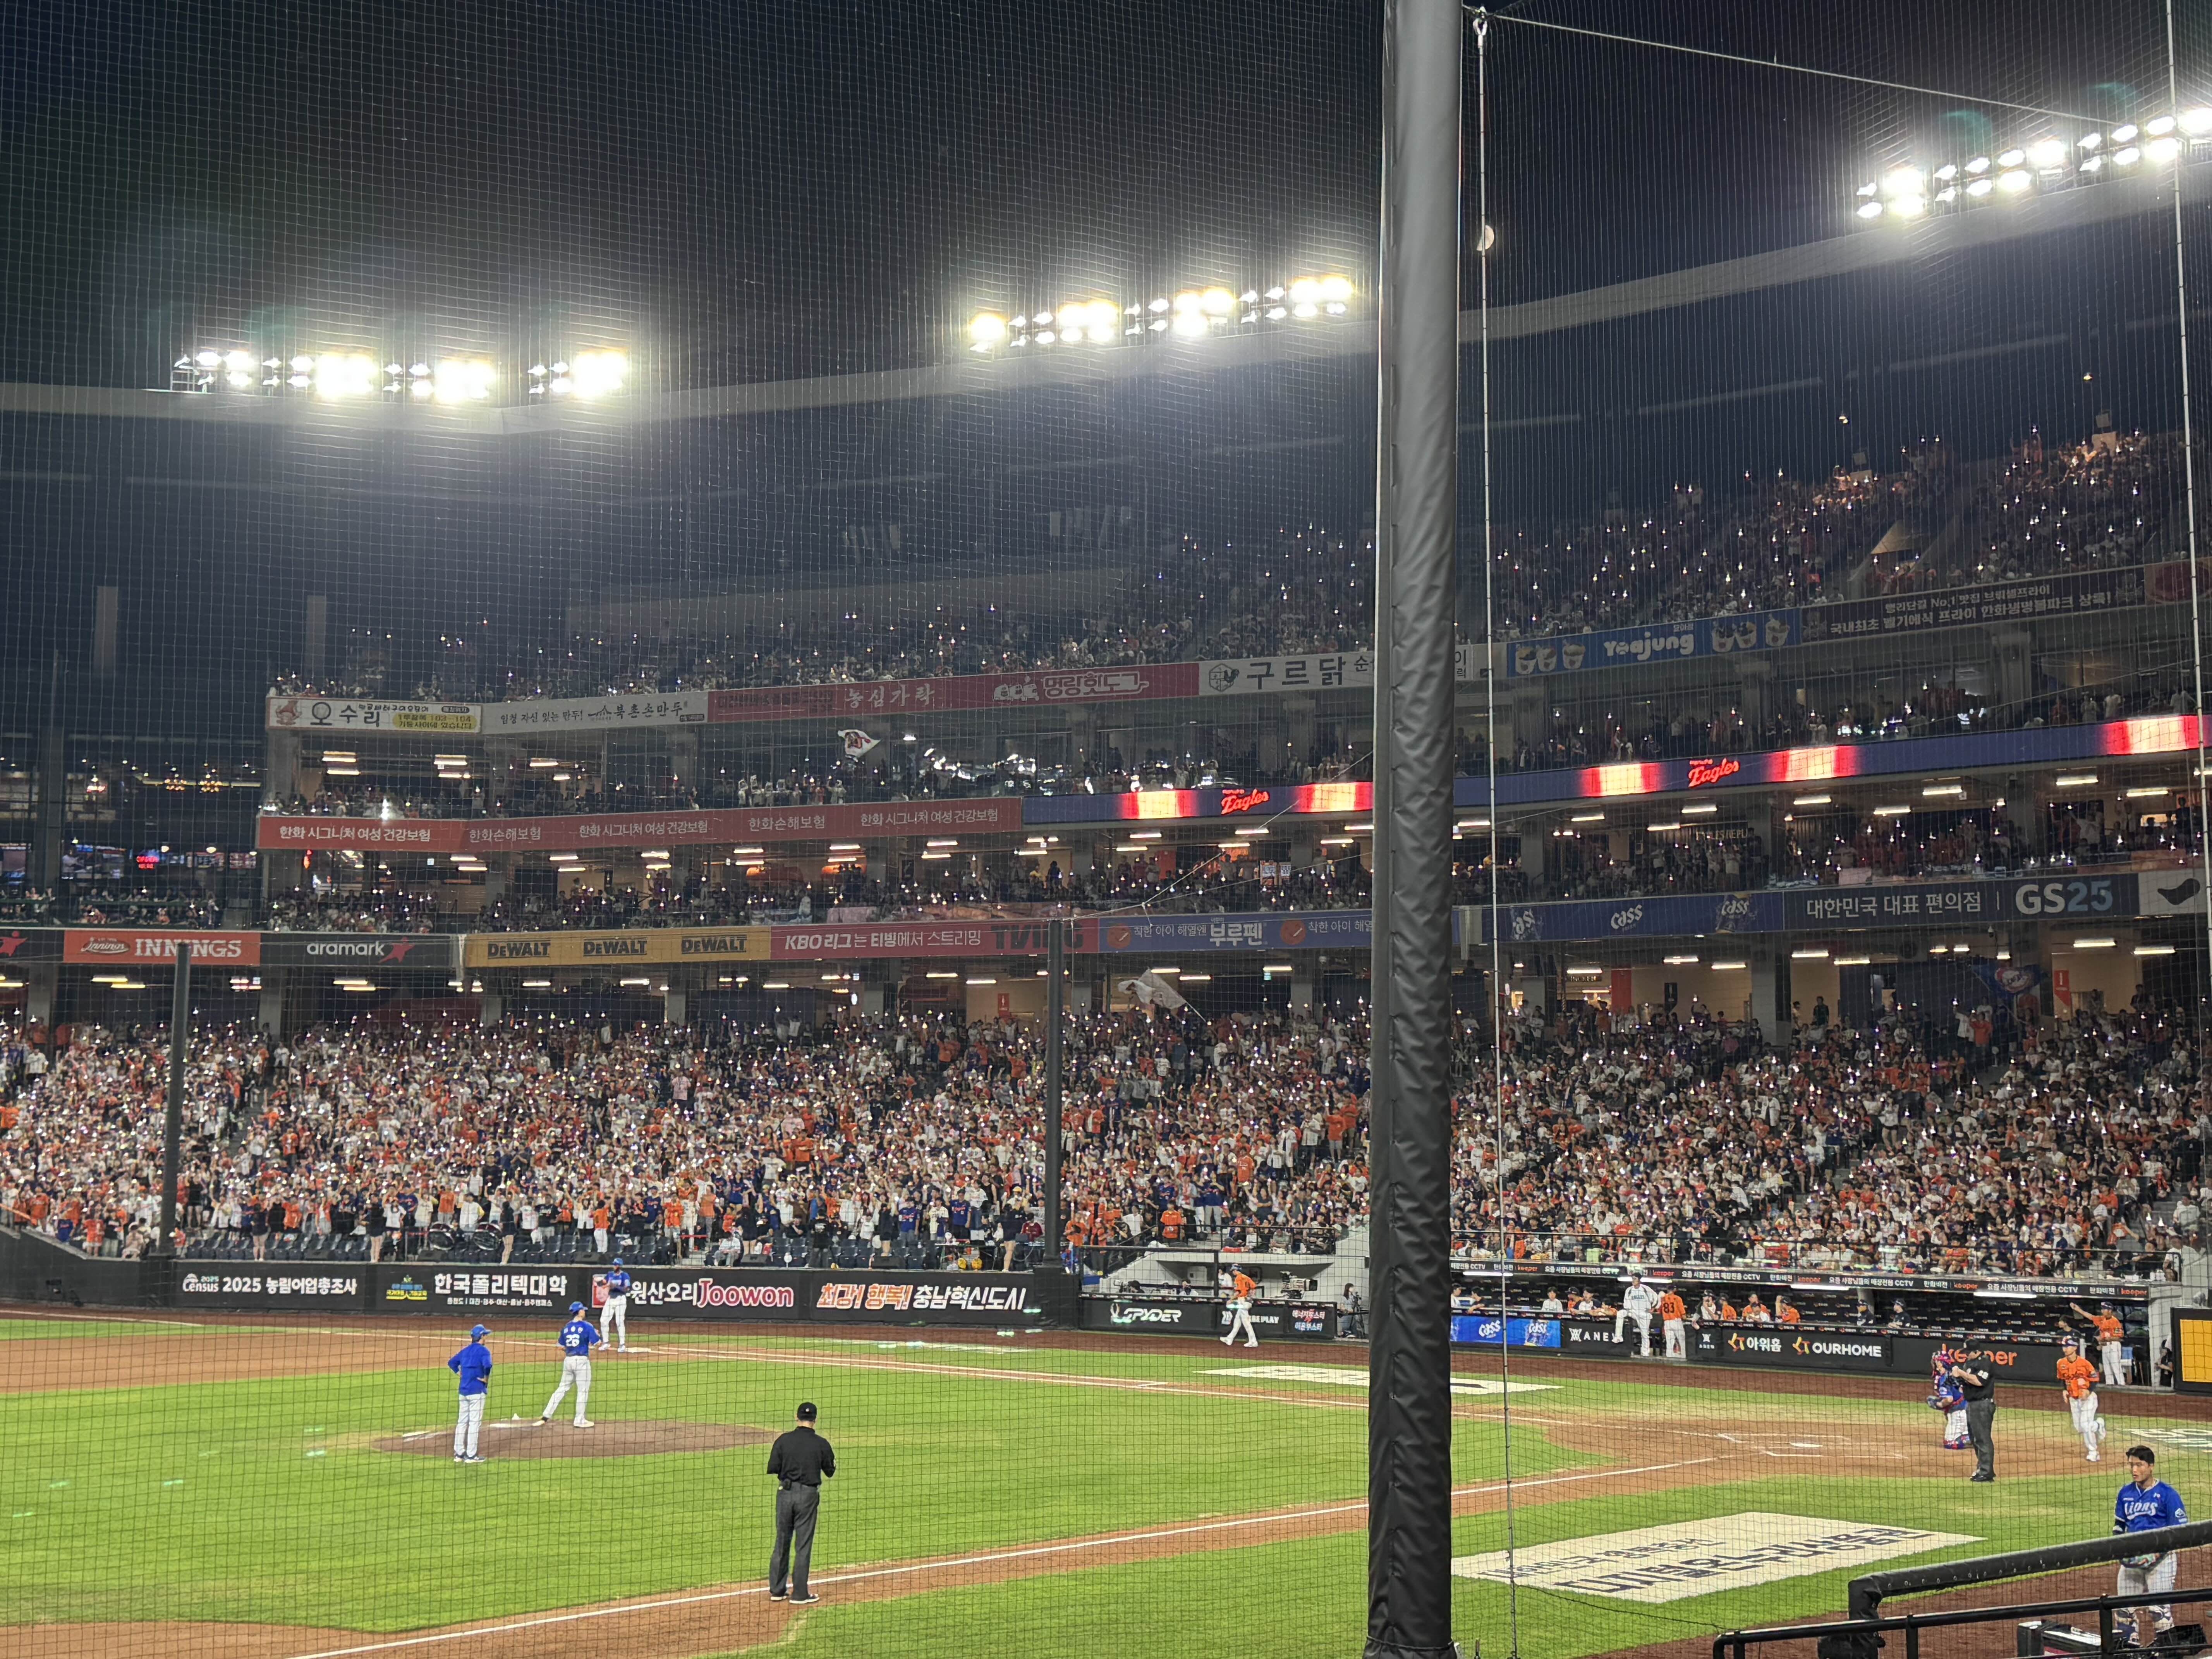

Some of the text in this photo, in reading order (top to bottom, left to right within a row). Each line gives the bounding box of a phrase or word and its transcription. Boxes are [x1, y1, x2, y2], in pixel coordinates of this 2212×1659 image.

[1939, 608, 1977, 622] 프라이
[1354, 655, 1374, 672] 순
[1247, 656, 1346, 690] 구르닭
[845, 683, 936, 709] 농심가락
[521, 712, 538, 723] 자신
[542, 711, 558, 722] 있는
[563, 710, 583, 721] 만두!
[613, 701, 683, 720] 북촌손만두
[1688, 758, 1740, 788] Eagles
[1221, 789, 1269, 815] Eagles
[748, 815, 826, 832] 한화손해보험
[861, 809, 998, 827] 한화 시그니처 여성 건강보험
[279, 826, 431, 842] 한화 시그니처 여성 건강보험
[469, 827, 541, 843] 한화손해보험
[579, 820, 708, 838] 한화 시그니처 여성 건강보험
[1807, 881, 2114, 919] 대한민국 대표 편의점 GS25
[1155, 924, 1175, 937] 아이
[1177, 923, 1207, 937] 해열엔
[1209, 923, 1264, 946] 부루펜
[1331, 920, 1351, 933] 아이
[134, 938, 242, 958] INNNGS
[306, 940, 385, 956] aramark
[785, 930, 982, 950] KBO리그는 티빙에서 스트리밍
[182, 1279, 219, 1293] Census
[222, 1277, 358, 1296] 2025 농림어업총조사
[434, 1273, 567, 1296] 한국폴리텍대학
[626, 1280, 697, 1306] 원산오리
[697, 1278, 794, 1308] Joowon
[2121, 1288, 2148, 1297] keeper
[816, 1282, 1027, 1310] 최강! 행복! 충남혁신도시
[1663, 1302, 1675, 1314] 83
[565, 1334, 580, 1347] 26
[1583, 1331, 1615, 1342] ANE
[1747, 1336, 1782, 1352] 아워홈
[1812, 1342, 1882, 1357] OURHOME
